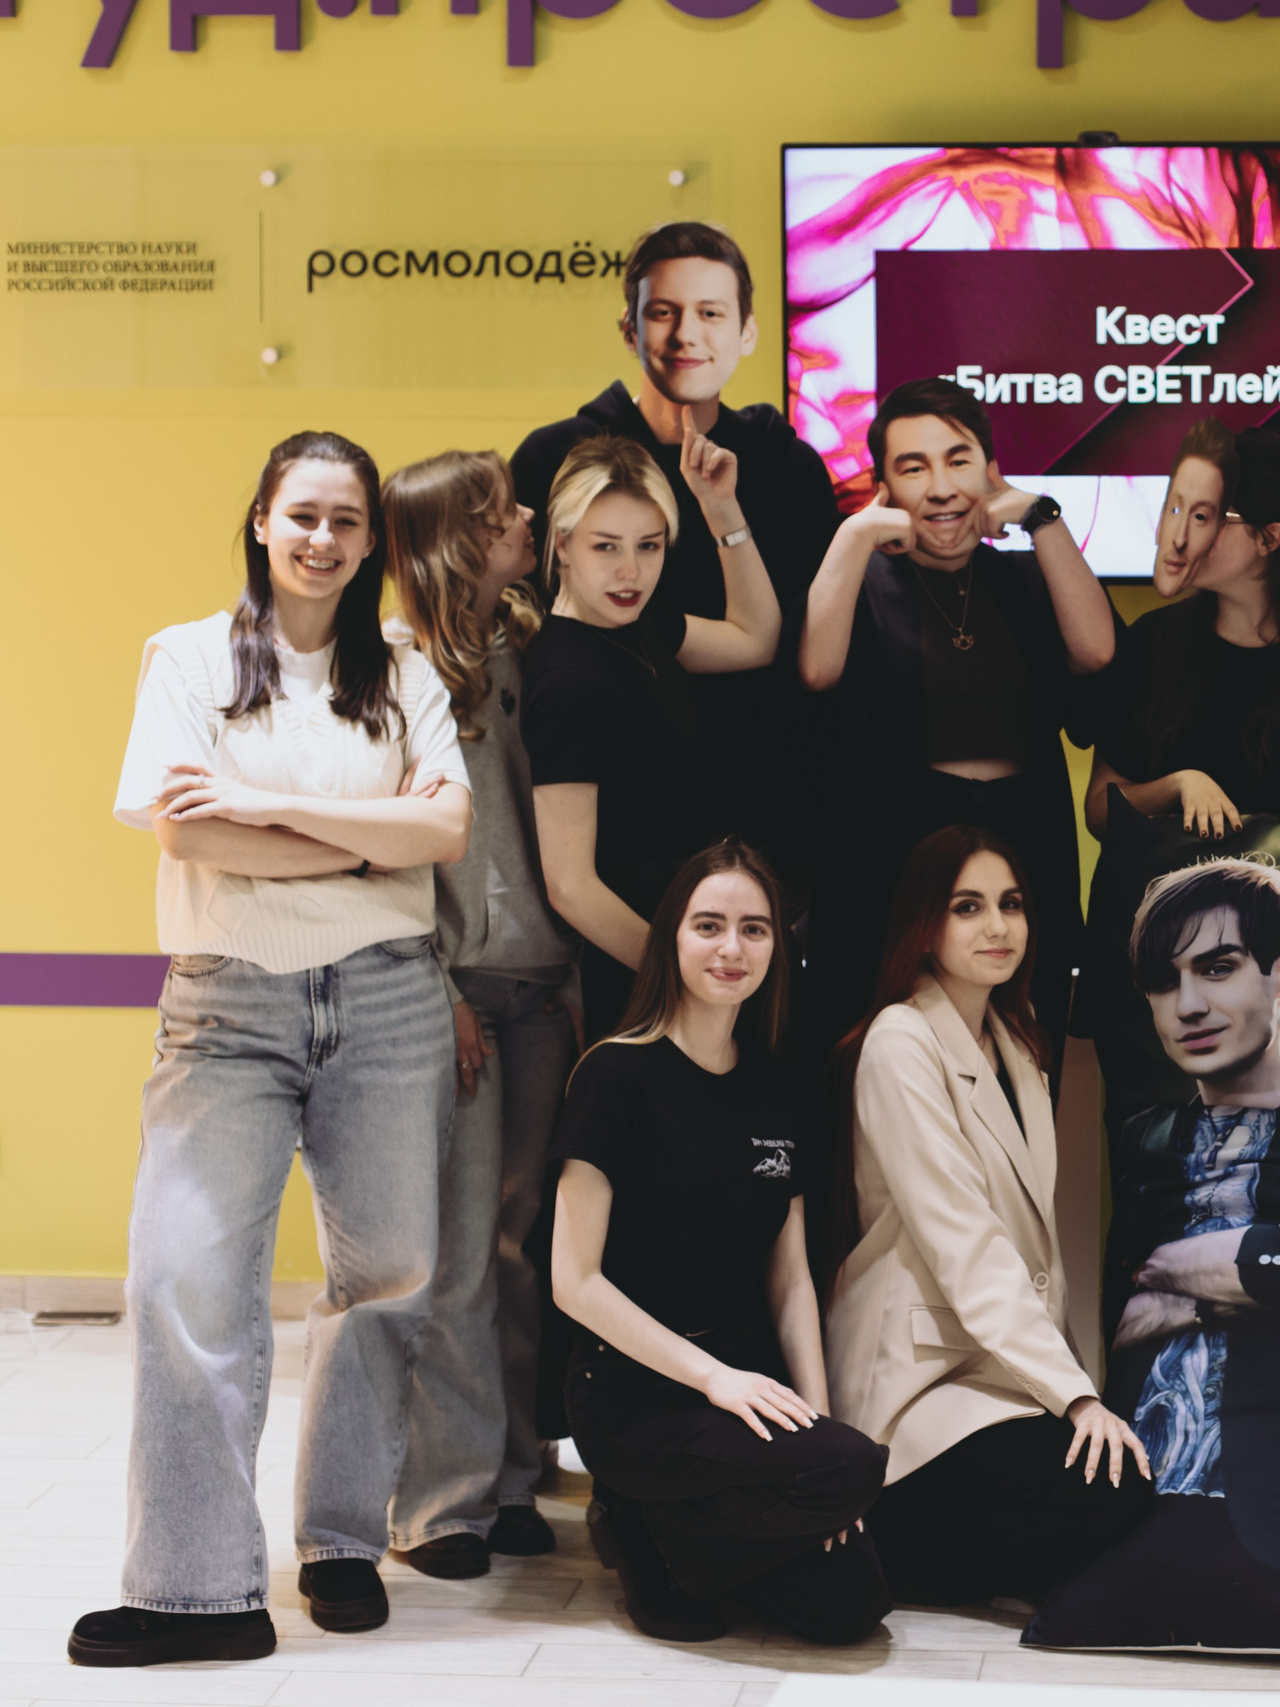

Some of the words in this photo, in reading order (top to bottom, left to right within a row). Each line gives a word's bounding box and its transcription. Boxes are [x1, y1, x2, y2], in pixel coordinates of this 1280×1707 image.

[7, 241, 136, 255] МИНИСТЕРСТВО
[141, 241, 198, 255] НАУКИ
[7, 260, 18, 273] И
[23, 260, 99, 274] ВЫСШЕГО
[102, 260, 216, 274] ОБРАЗОВАНИЯ
[307, 241, 627, 293] росмолодёж
[7, 276, 115, 292] РОССИЙСКОЙ
[119, 278, 215, 294] ФЕДЕРАЦИИ
[1096, 306, 1225, 345] Квест
[938, 365, 1083, 404] Битва
